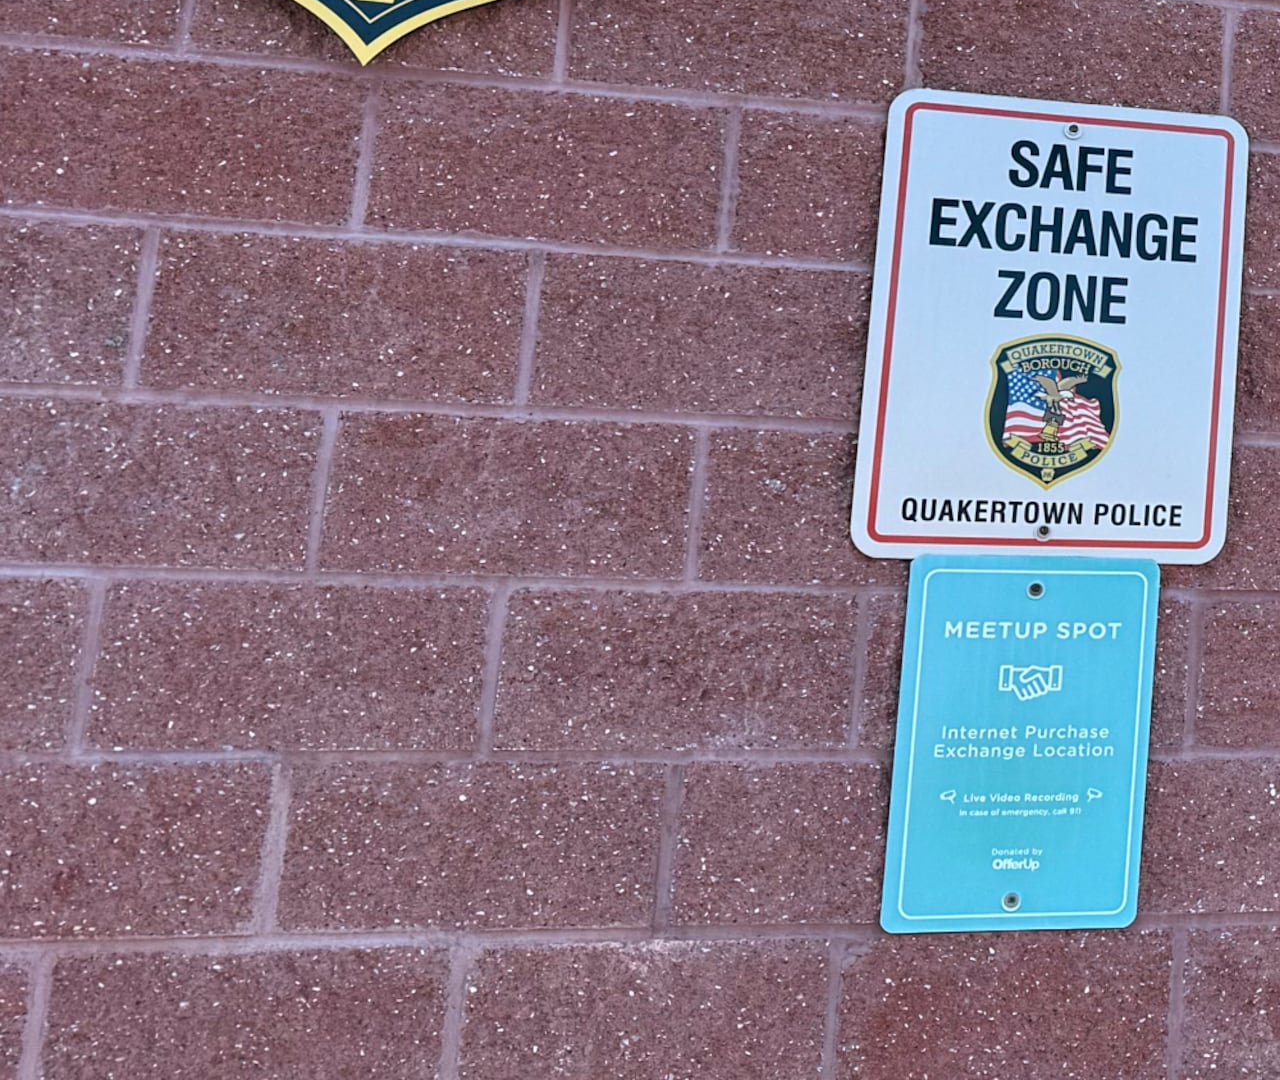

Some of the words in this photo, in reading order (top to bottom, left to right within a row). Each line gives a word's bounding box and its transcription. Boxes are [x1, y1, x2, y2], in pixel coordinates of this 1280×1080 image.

[1008, 140, 1134, 195] SAFE
[929, 197, 1199, 263] EXCHANGE
[994, 270, 1128, 324] ZONE
[1011, 344, 1105, 366] QUAKERTOWN
[1021, 358, 1091, 374] BOROUGH
[1038, 442, 1065, 453] 1855
[1020, 452, 1078, 466] POLICE
[901, 497, 1084, 525] QUAKERTOWN
[1094, 502, 1183, 527] POLICE
[944, 621, 1048, 639] MEETUP
[1056, 622, 1123, 639] SPOT
[941, 726, 1017, 739] Internet
[1025, 725, 1109, 739] Purchase
[934, 744, 1025, 760] Exchange
[1033, 743, 1114, 757] Location
[963, 793, 986, 803] Live
[989, 793, 1021, 802] Video
[1024, 792, 1079, 803] Recording
[992, 858, 1040, 871] OfferUp
